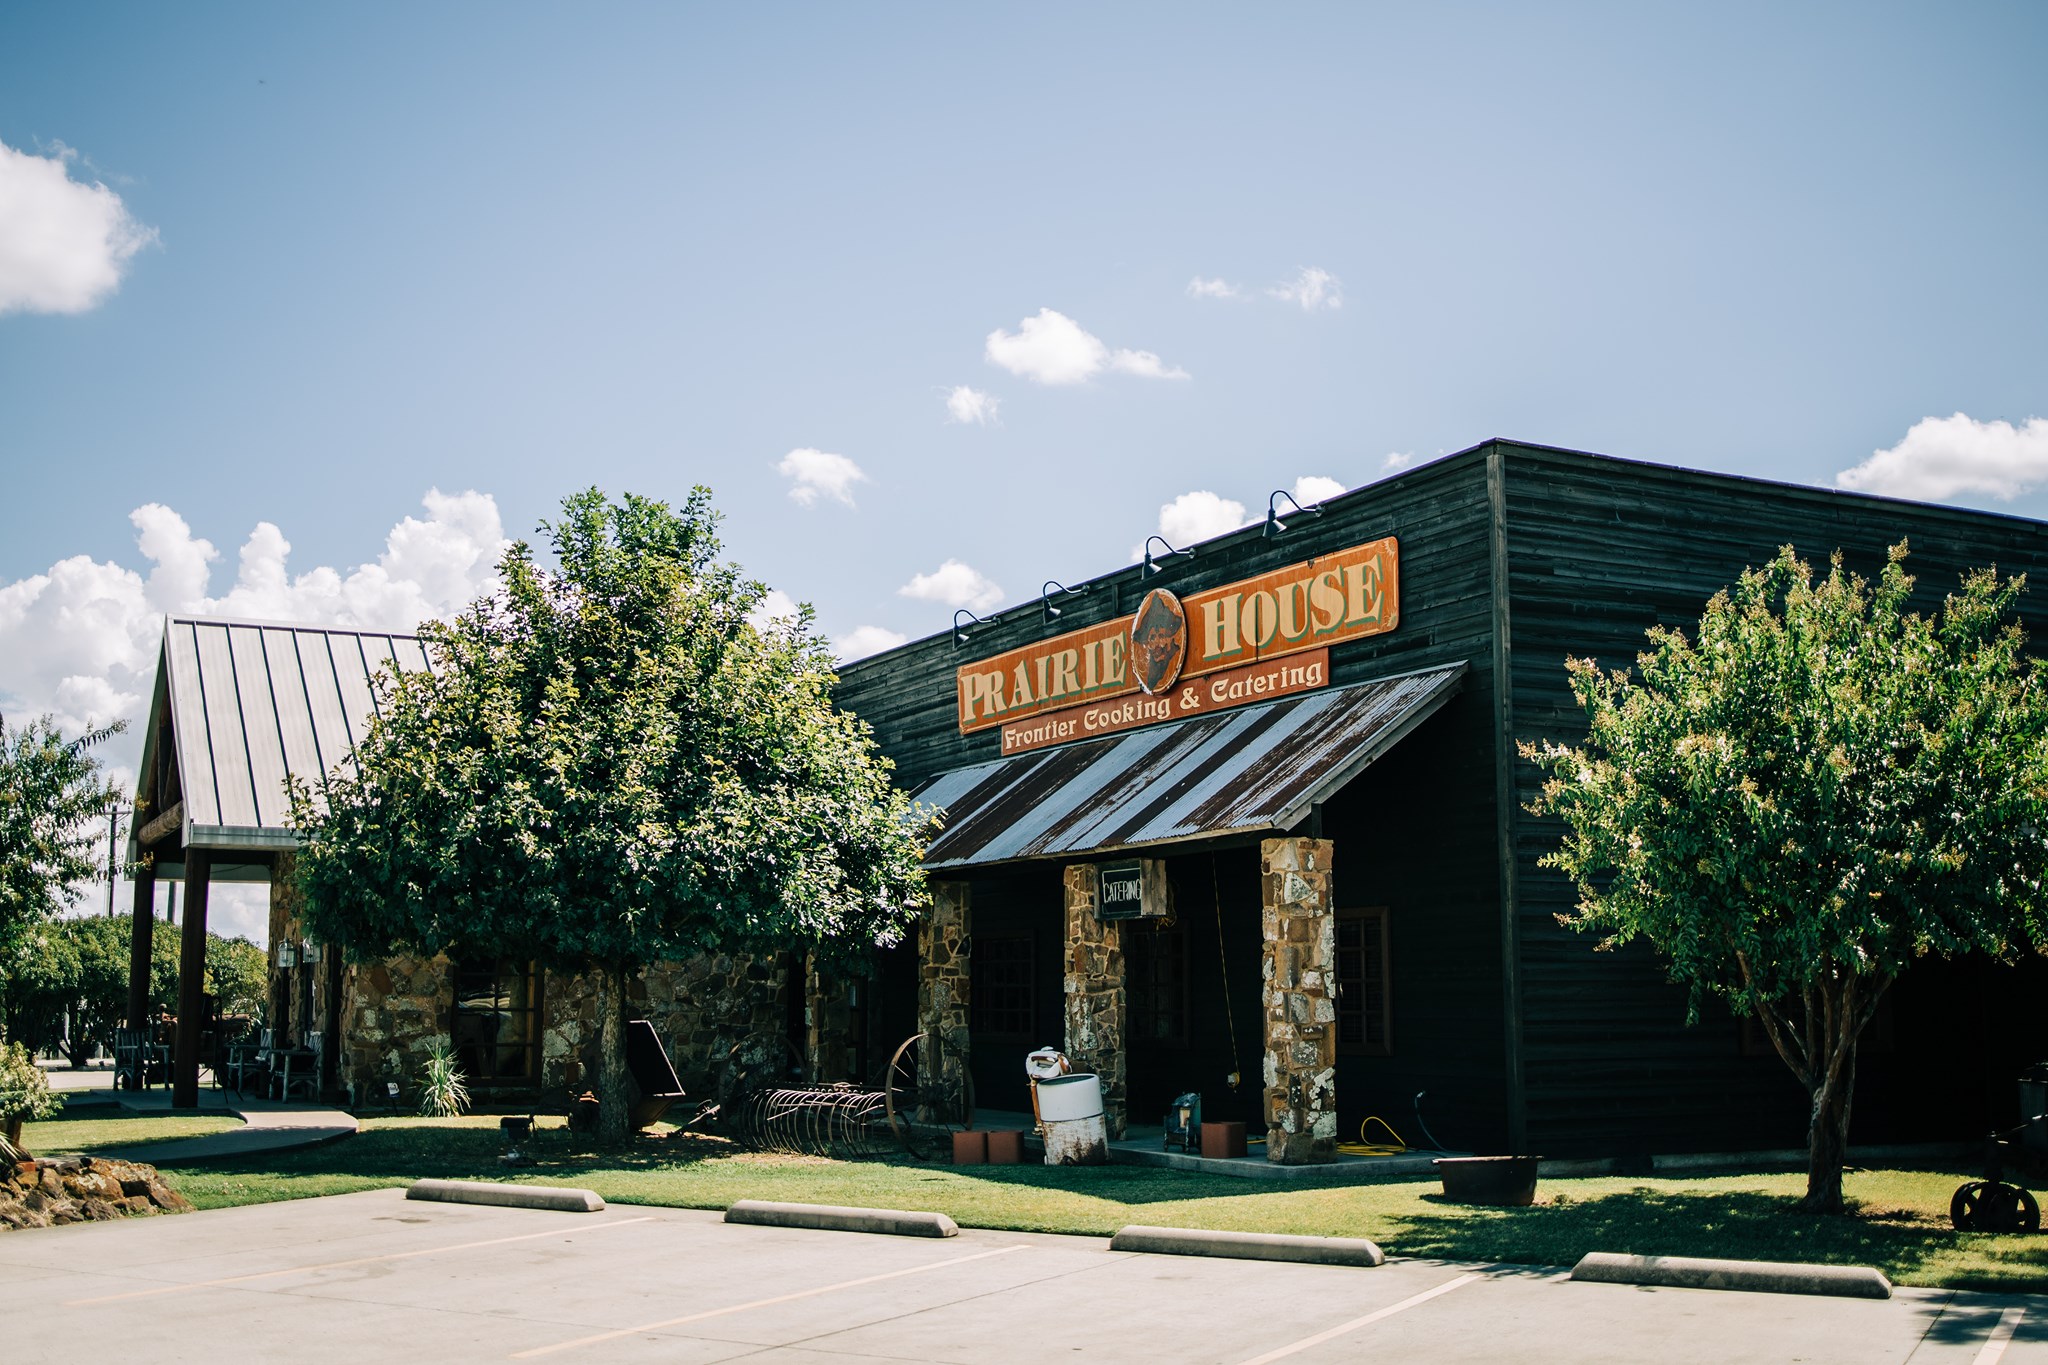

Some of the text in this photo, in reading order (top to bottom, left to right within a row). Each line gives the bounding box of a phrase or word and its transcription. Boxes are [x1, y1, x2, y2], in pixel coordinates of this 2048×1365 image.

[960, 555, 1384, 724] PRAIRIE HOUSE
[1004, 662, 1322, 750] Frontier Cooking & Catering
[1103, 879, 1141, 903] CATERING
